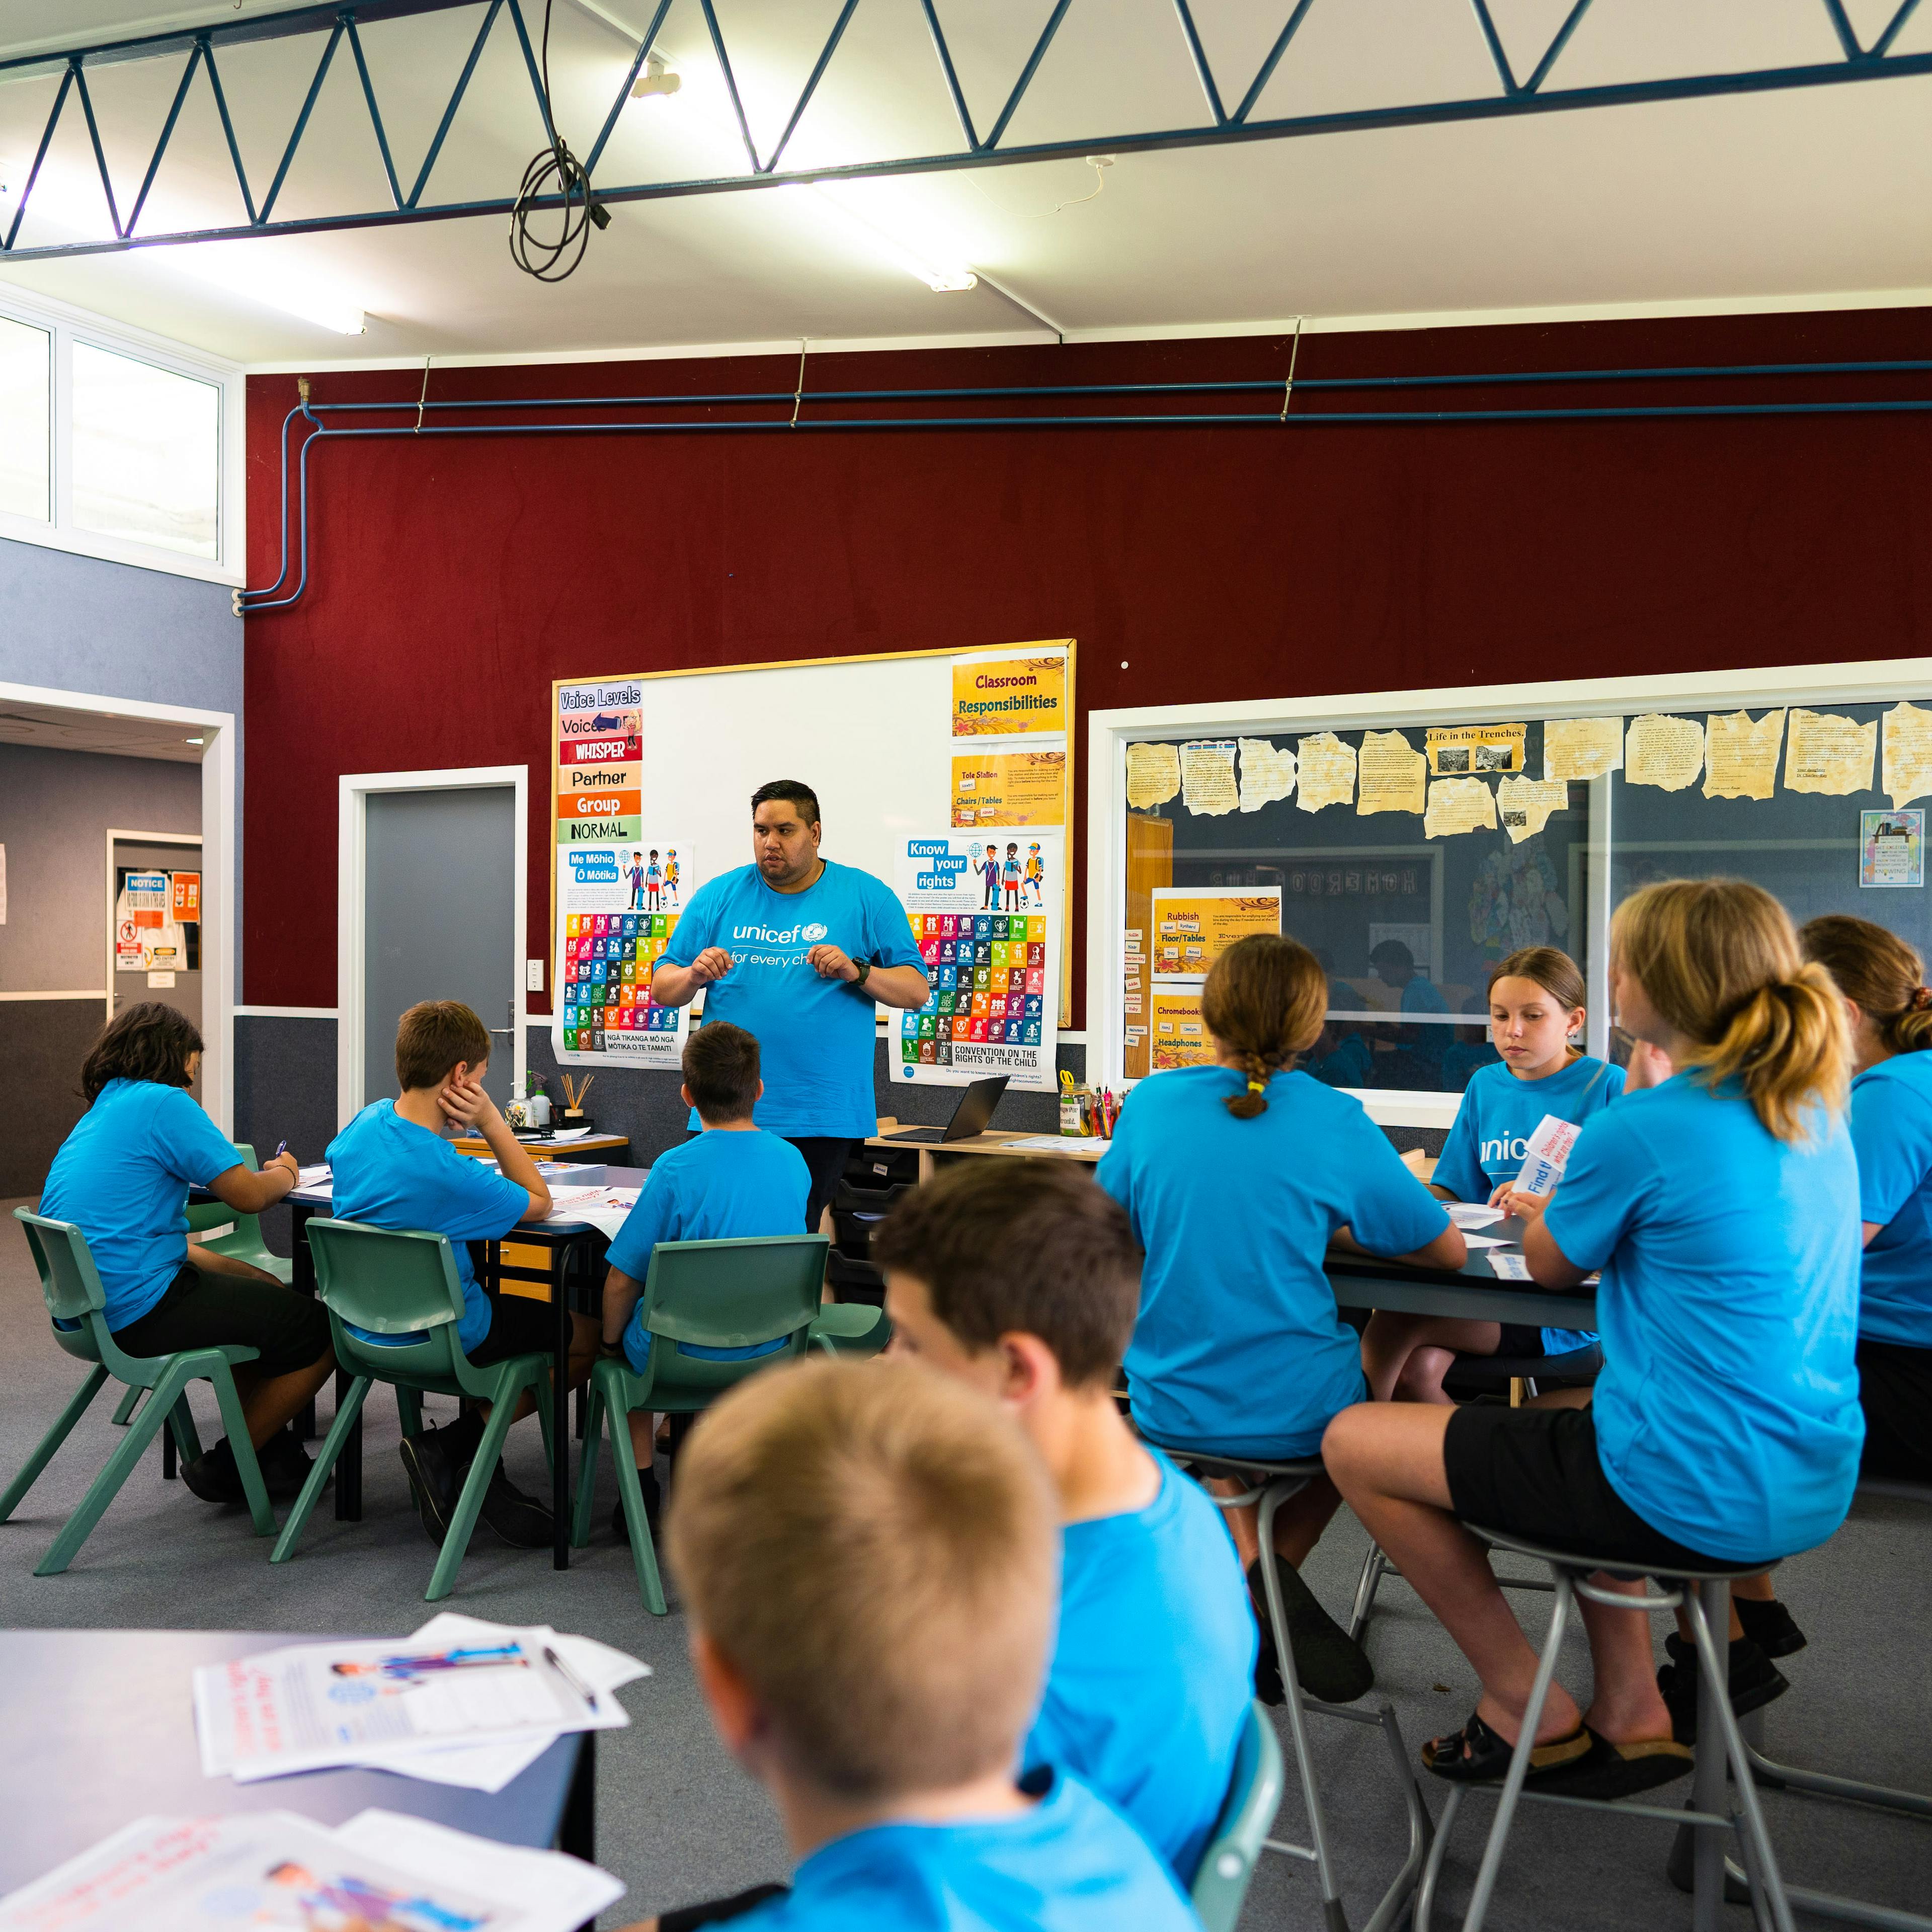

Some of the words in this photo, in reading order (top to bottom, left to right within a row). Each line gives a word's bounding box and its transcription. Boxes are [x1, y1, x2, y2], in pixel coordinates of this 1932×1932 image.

[976, 674, 1037, 689] Classroom
[560, 691, 595, 710] Voice
[598, 686, 641, 706] Levels
[959, 694, 1058, 715] Responsibilities
[1429, 733, 1447, 741] Life
[1479, 730, 1524, 739] Trenches.
[576, 741, 626, 760] WHISPER
[573, 770, 626, 787] Partner
[577, 797, 621, 816] Group
[571, 822, 627, 840] NORMAL
[911, 843, 945, 855] Know
[571, 854, 584, 864] Me
[936, 859, 964, 871] your
[131, 879, 163, 888] NOTICE
[919, 874, 954, 890] rights
[1168, 912, 1199, 920] Rubbish
[733, 924, 801, 944] unicef
[731, 951, 748, 964] for
[750, 954, 790, 968] every
[1159, 1038, 1202, 1048] Headphones
[955, 1046, 1005, 1057] CONVENTION
[1008, 1050, 1019, 1058] ON
[1022, 1051, 1037, 1059] THE
[955, 1055, 983, 1064] RIGHTS
[997, 1058, 1012, 1066] THE
[1015, 1058, 1037, 1067] CHILD
[1541, 1134, 1560, 1157] Children's
[1557, 1121, 1569, 1136] rights
[1563, 1132, 1574, 1146] they?
[1481, 1131, 1528, 1164] nic
[1560, 1145, 1569, 1153] are
[1554, 1151, 1565, 1164] what
[1528, 1168, 1549, 1194] Find
